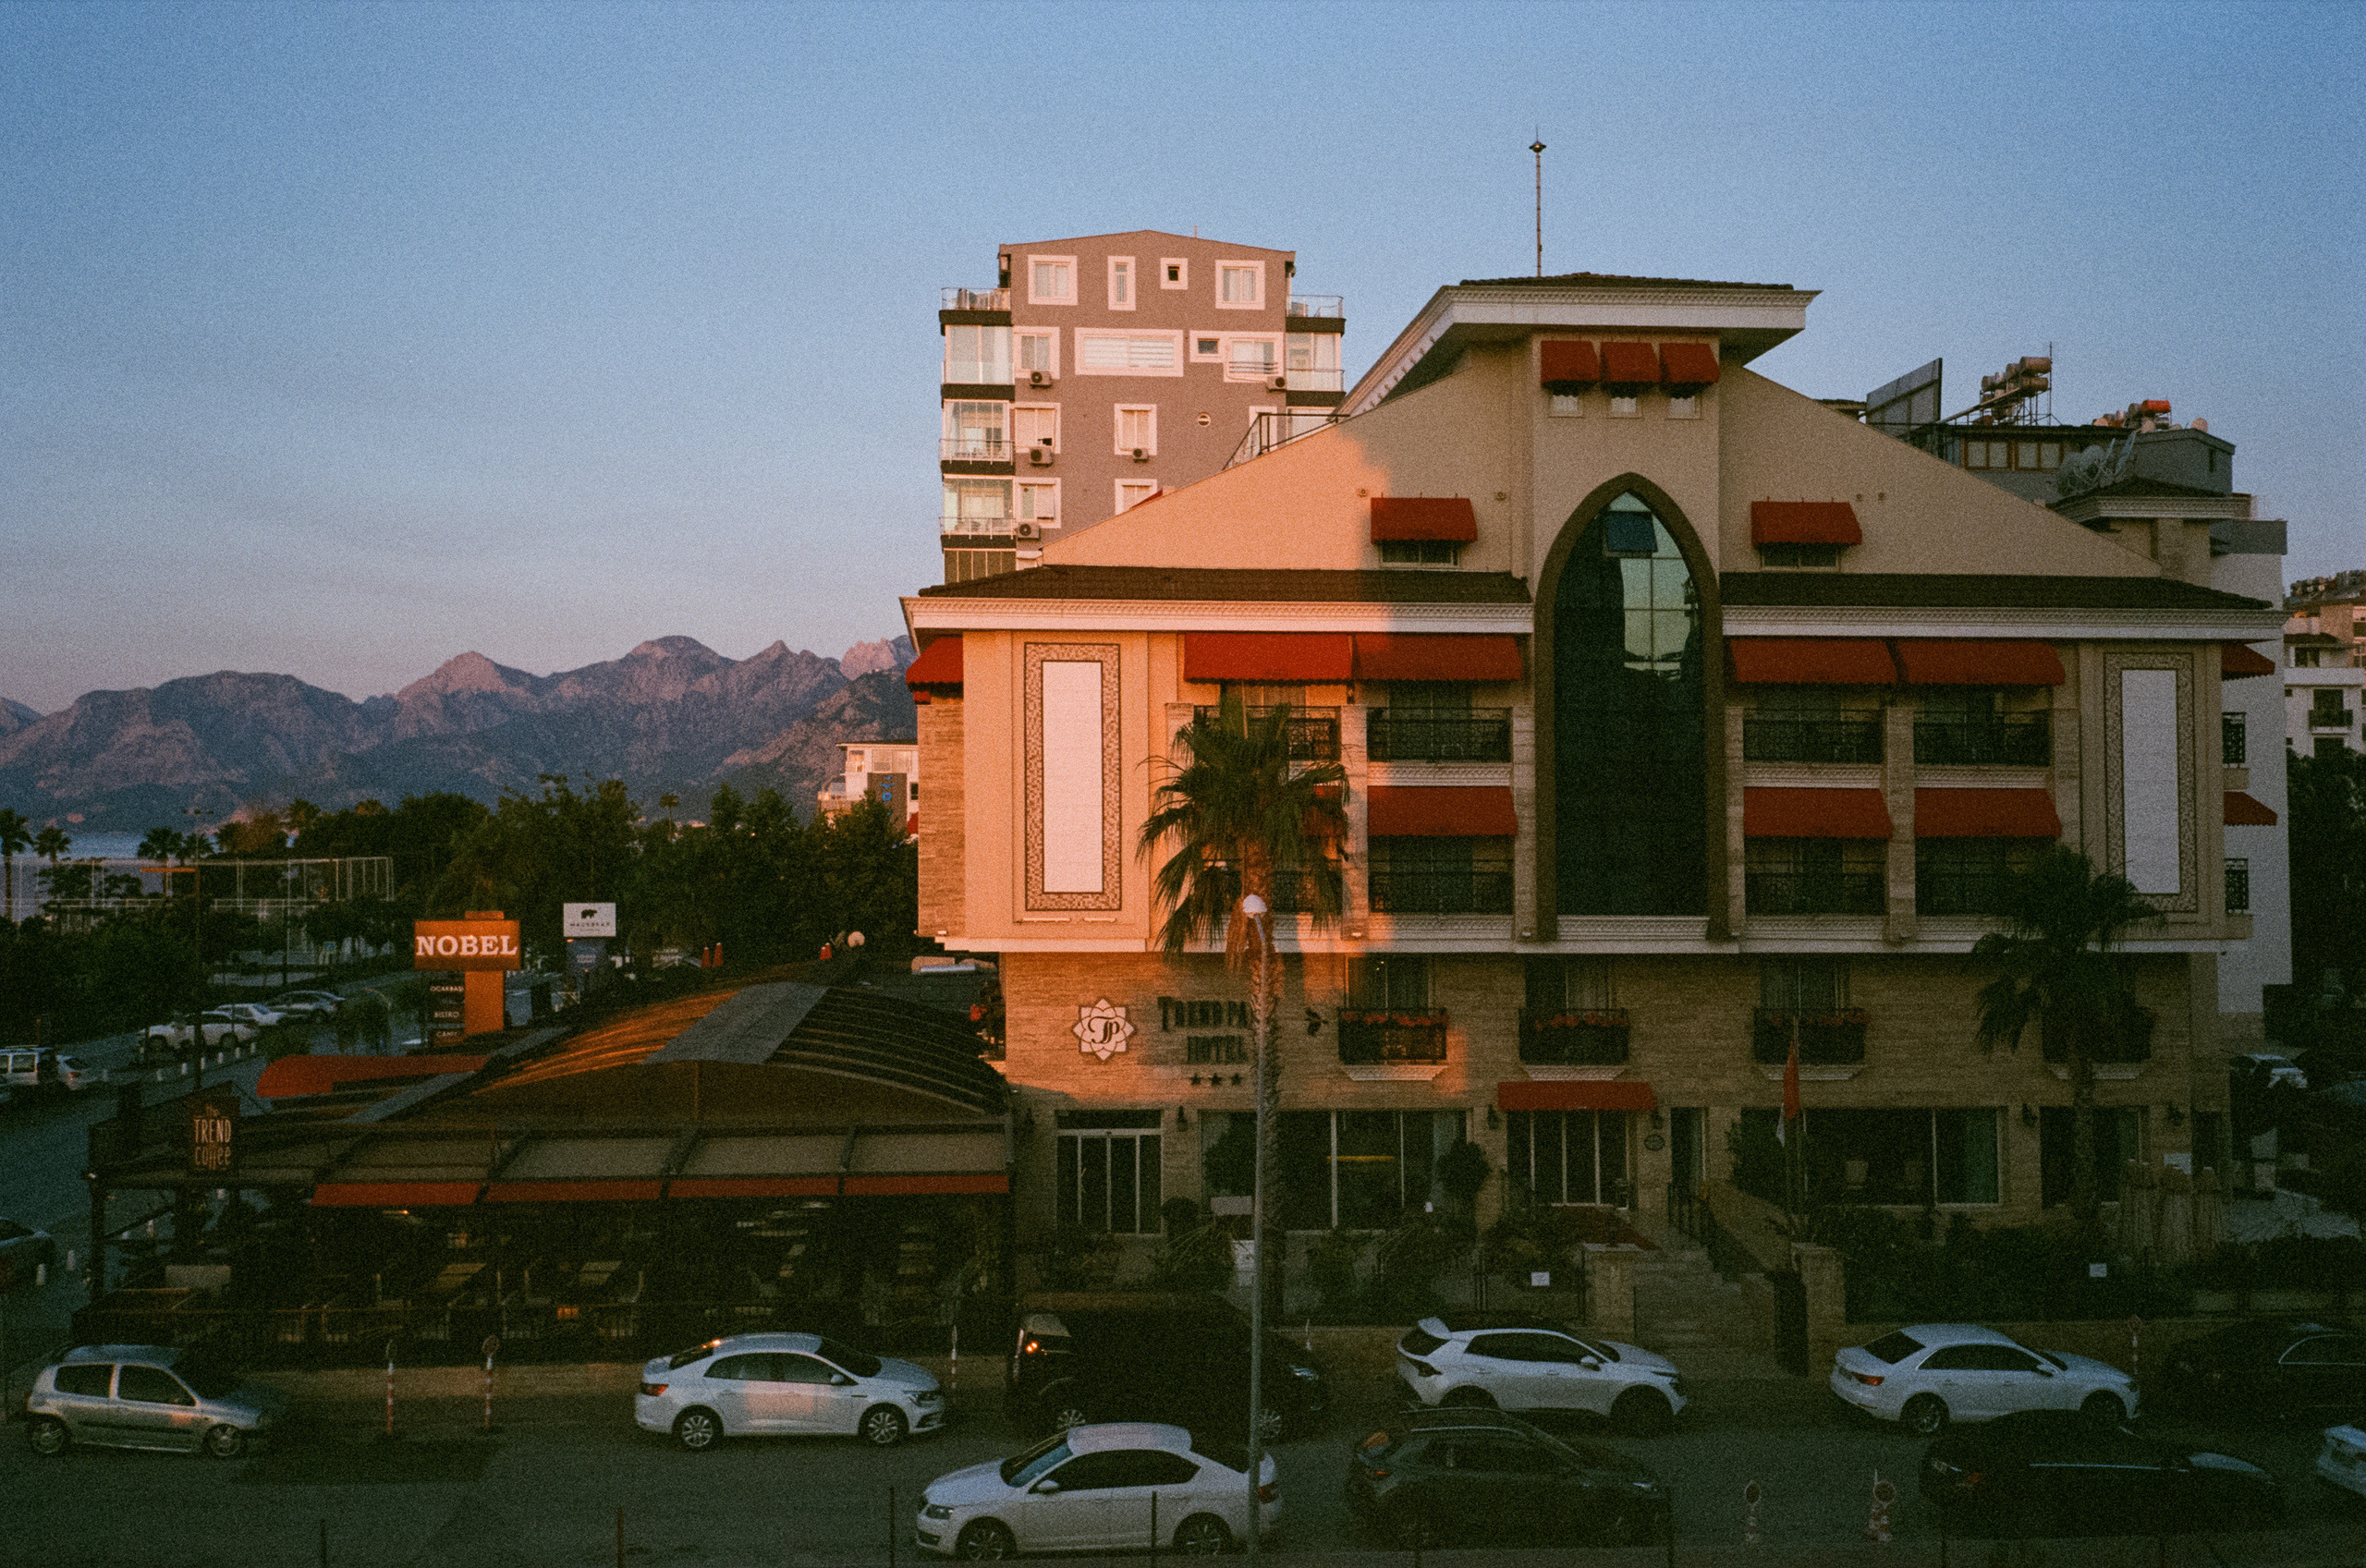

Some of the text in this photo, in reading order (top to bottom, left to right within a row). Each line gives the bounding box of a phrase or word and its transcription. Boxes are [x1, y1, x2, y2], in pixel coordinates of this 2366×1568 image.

[416, 935, 518, 956] NOBEL
[1187, 1036, 1248, 1064] HOTEL
[193, 1118, 232, 1143] TREND
